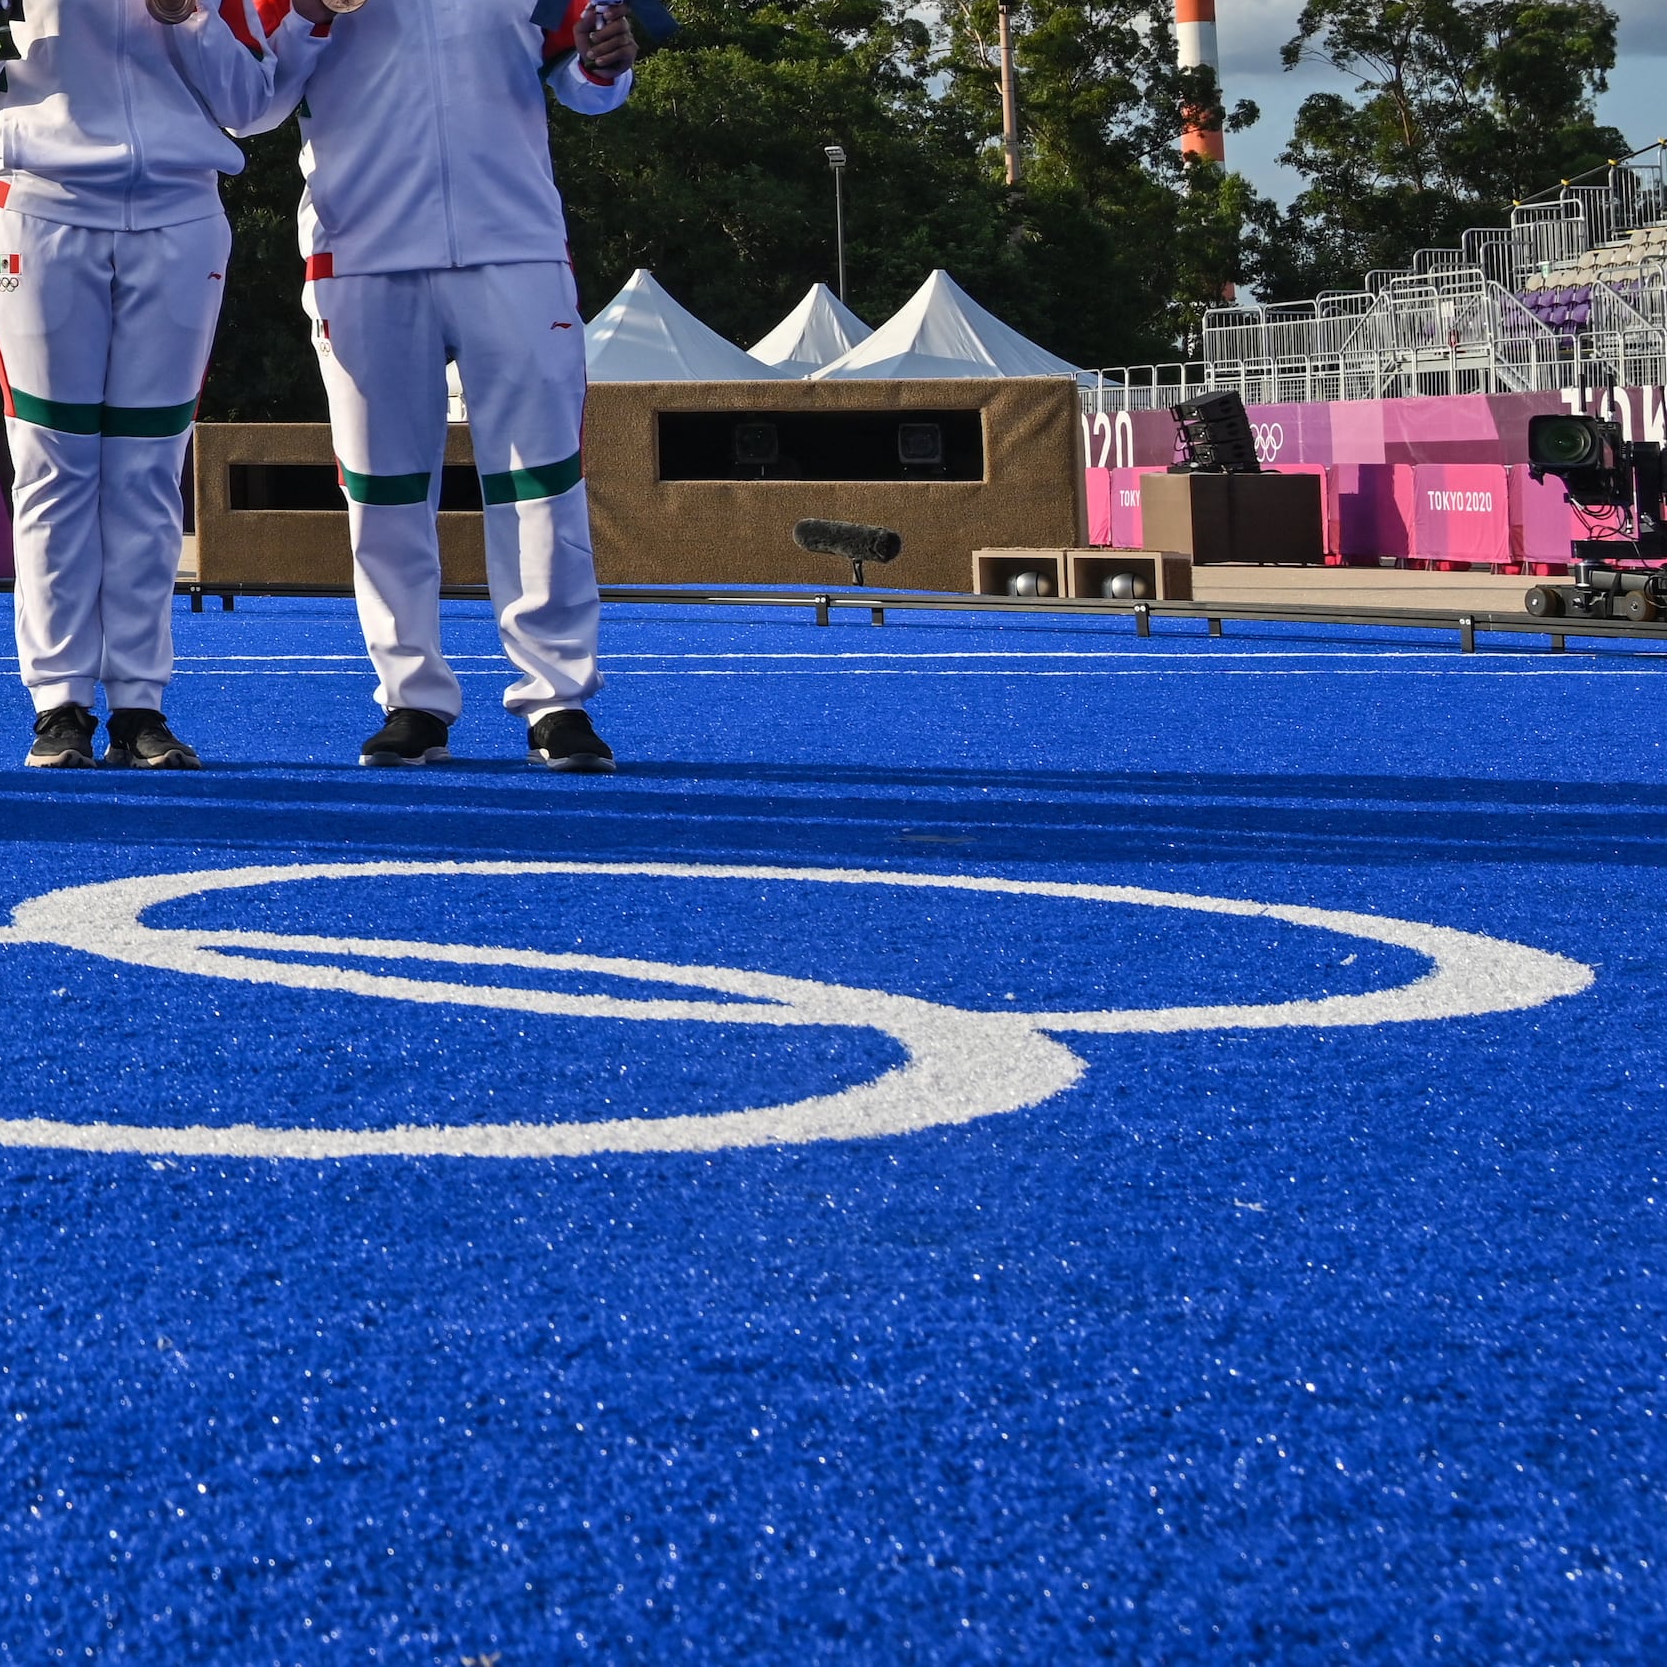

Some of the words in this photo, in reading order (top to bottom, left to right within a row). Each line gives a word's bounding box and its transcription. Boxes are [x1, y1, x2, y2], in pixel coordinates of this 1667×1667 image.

[1119, 490, 1141, 507] TOKY
[1427, 490, 1464, 511] TOKYO
[1466, 491, 1493, 512] 2020
